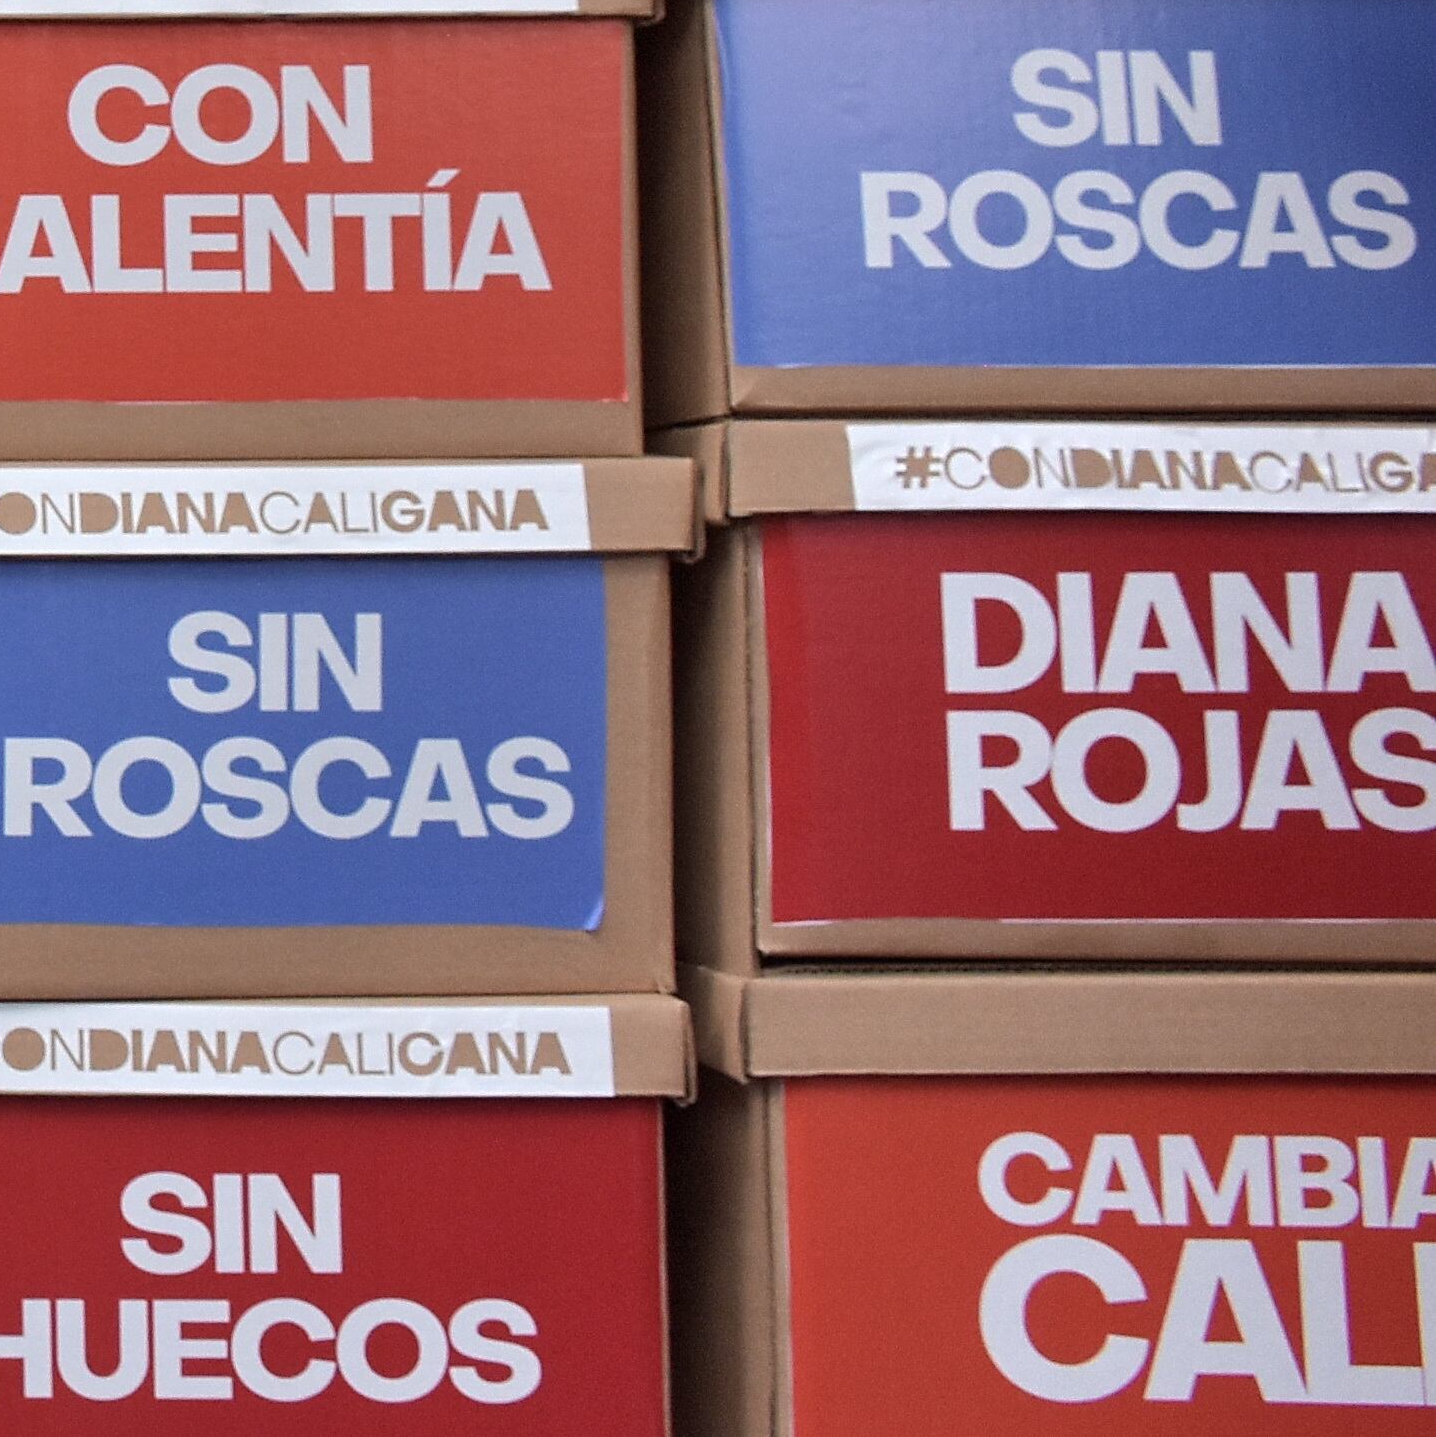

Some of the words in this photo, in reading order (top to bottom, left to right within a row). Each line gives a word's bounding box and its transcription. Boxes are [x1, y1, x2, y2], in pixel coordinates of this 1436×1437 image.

[69, 65, 372, 165] CON
[1012, 49, 1221, 147] SIN
[861, 171, 1415, 269] ROSCAS
[895, 447, 1436, 493] #CONDIANACALIG
[170, 612, 381, 712] SIN
[942, 573, 1436, 692] DIANA
[5, 738, 573, 838] ROSCAS
[947, 709, 1436, 831] ROJAS
[122, 1173, 341, 1274] SIN
